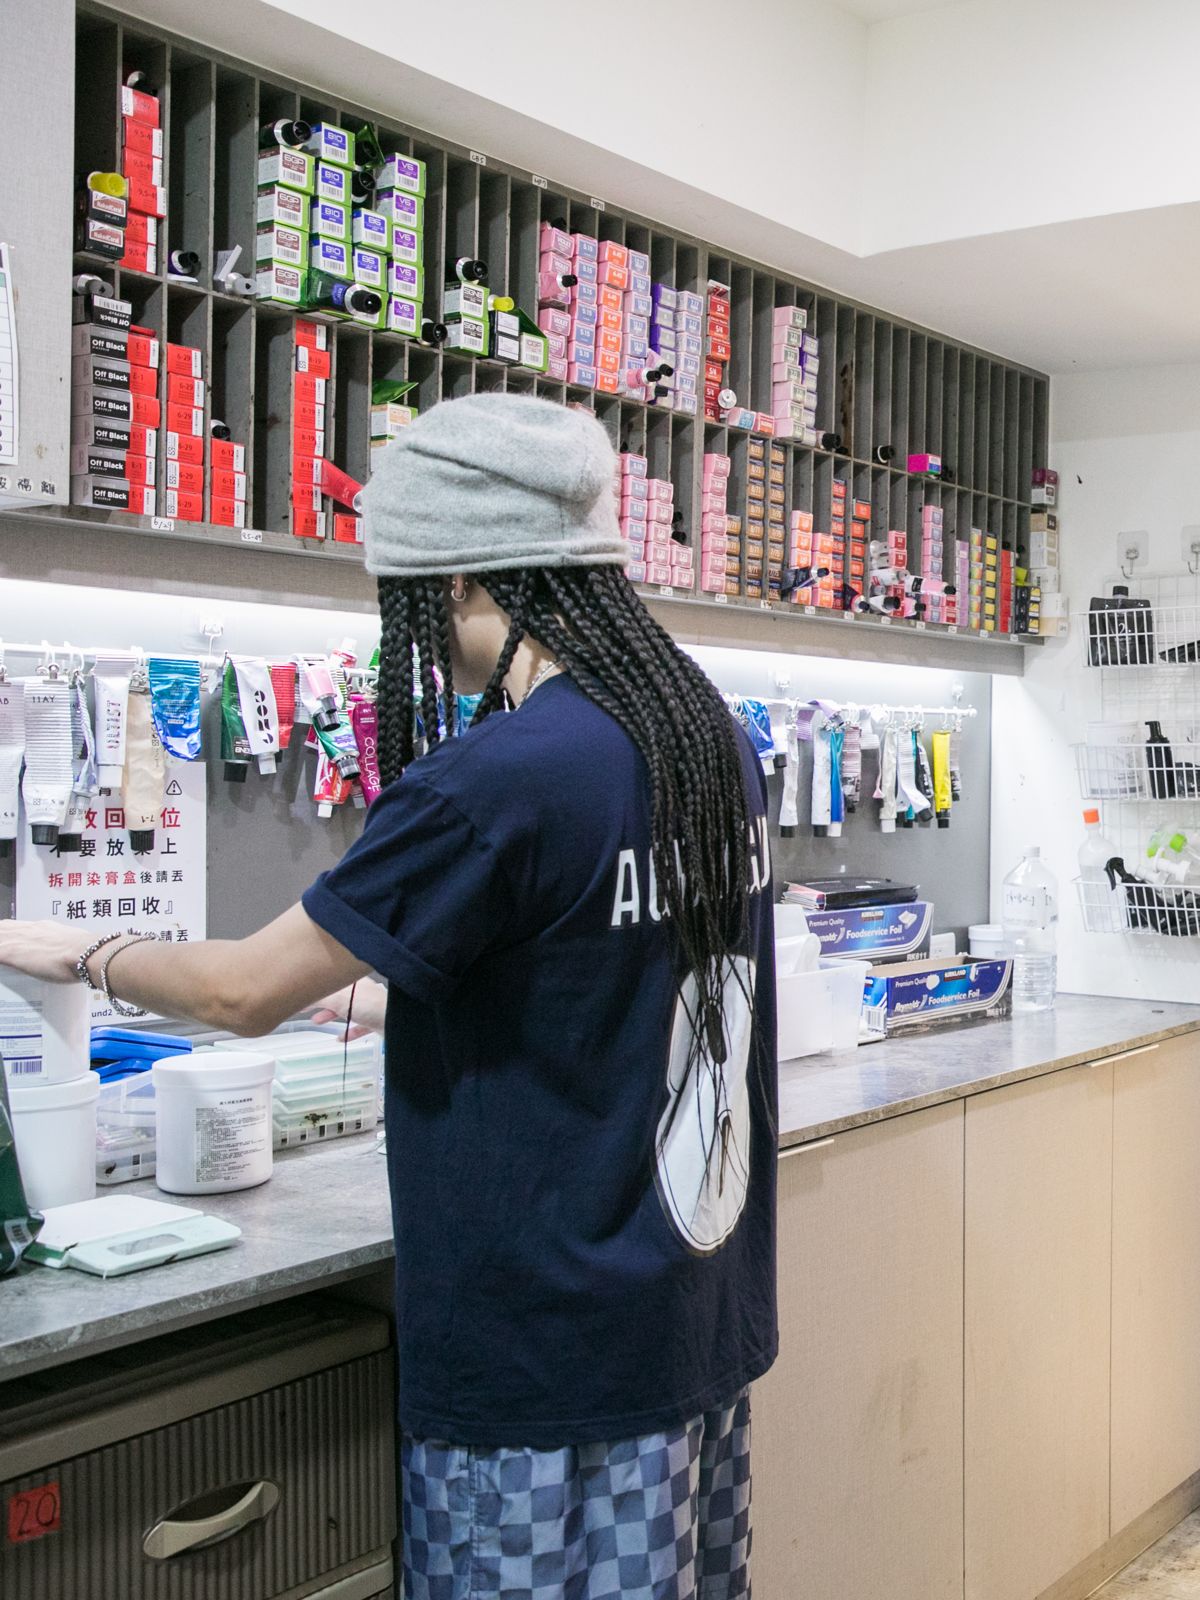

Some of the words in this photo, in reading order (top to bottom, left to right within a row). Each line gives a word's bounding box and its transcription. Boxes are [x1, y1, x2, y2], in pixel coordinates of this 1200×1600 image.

[92, 339, 105, 347] Off
[106, 341, 126, 352] Black
[95, 370, 107, 378] Off
[108, 371, 128, 382] Black
[95, 400, 107, 408] Off
[108, 402, 128, 412] Black
[96, 430, 108, 438] Off
[109, 431, 129, 442] Black
[90, 459, 102, 467] Off
[103, 460, 124, 470] Black
[94, 489, 106, 497] Off
[107, 491, 127, 501] Black
[49, 870, 183, 888] 拆開染膏盒後請丟
[52, 897, 173, 920] 『紙類回收』
[809, 919, 828, 927] Premium
[829, 918, 845, 926] Quality
[846, 927, 888, 939] Foodservice
[889, 924, 903, 934] Foil
[895, 978, 914, 988] Premium
[928, 992, 967, 1005] Foodservice
[968, 989, 980, 999] Foil
[18, 1491, 57, 1537] 20
